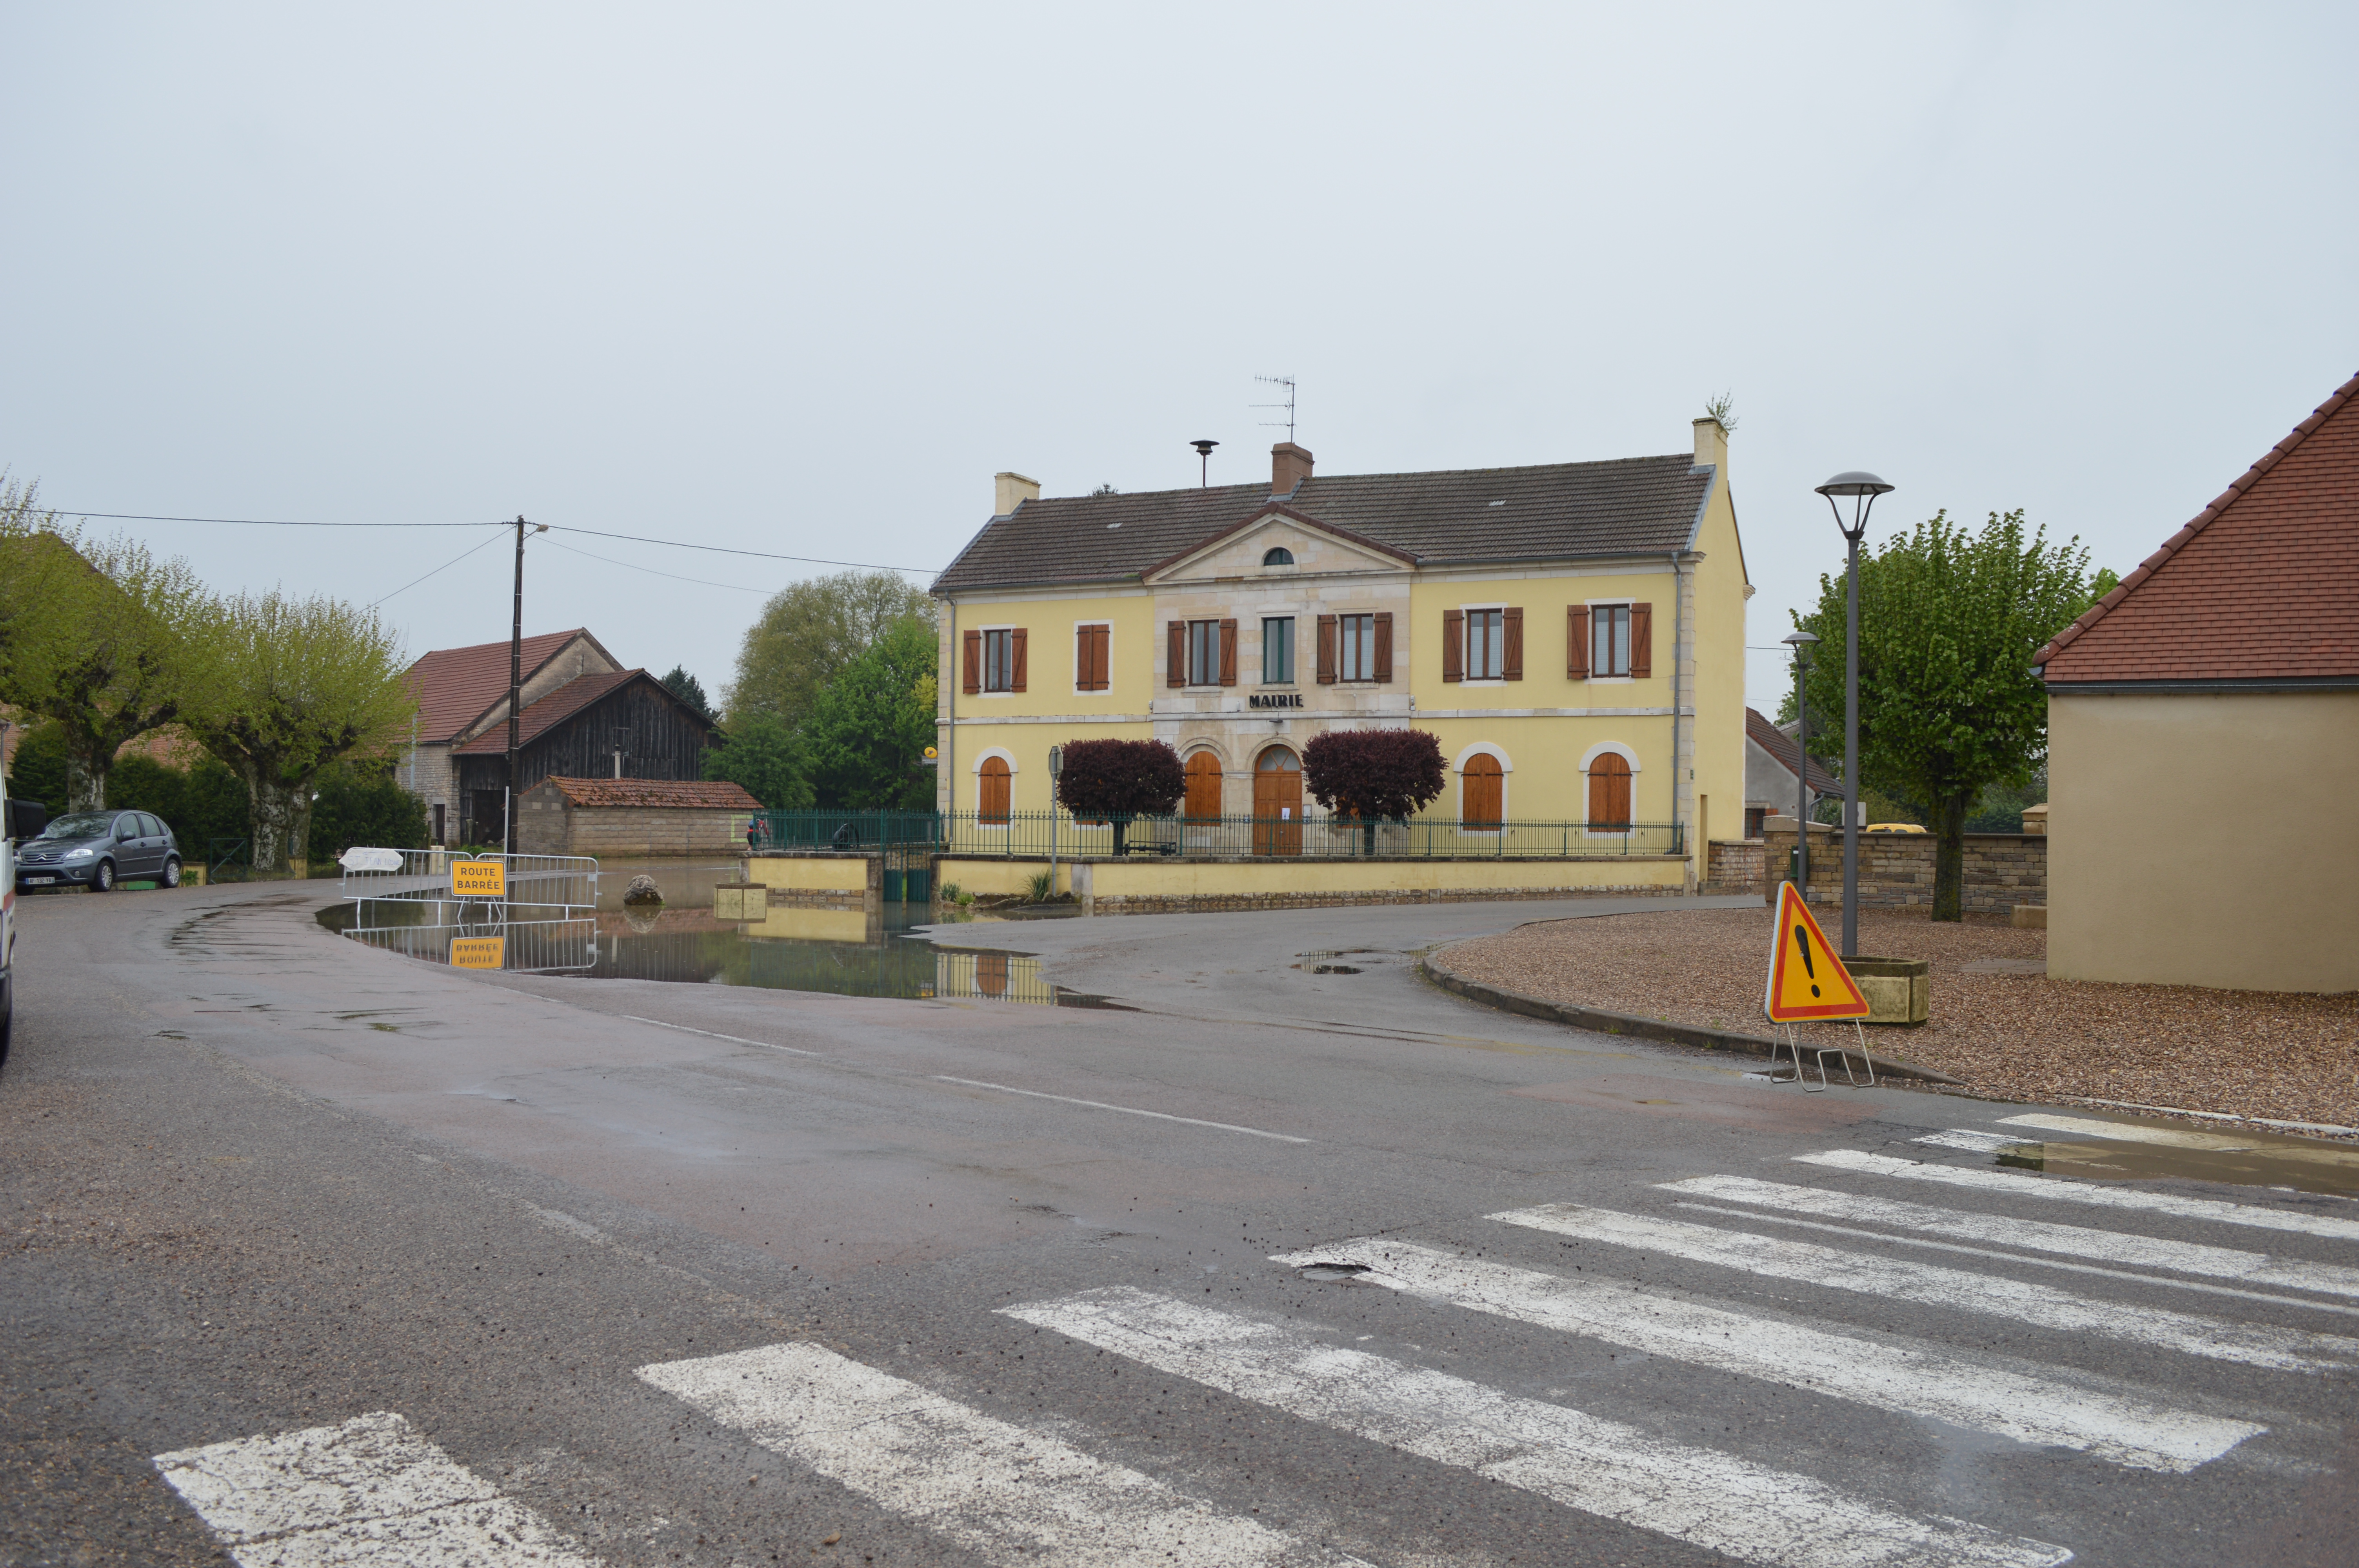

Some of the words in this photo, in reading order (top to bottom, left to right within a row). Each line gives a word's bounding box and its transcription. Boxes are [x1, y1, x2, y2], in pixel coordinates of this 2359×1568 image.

[1249, 694, 1304, 708] MAIRIE
[348, 856, 360, 865] ST
[361, 857, 382, 865] JEAN
[461, 867, 496, 876] ROUTE
[457, 878, 500, 889] BARRÉE
